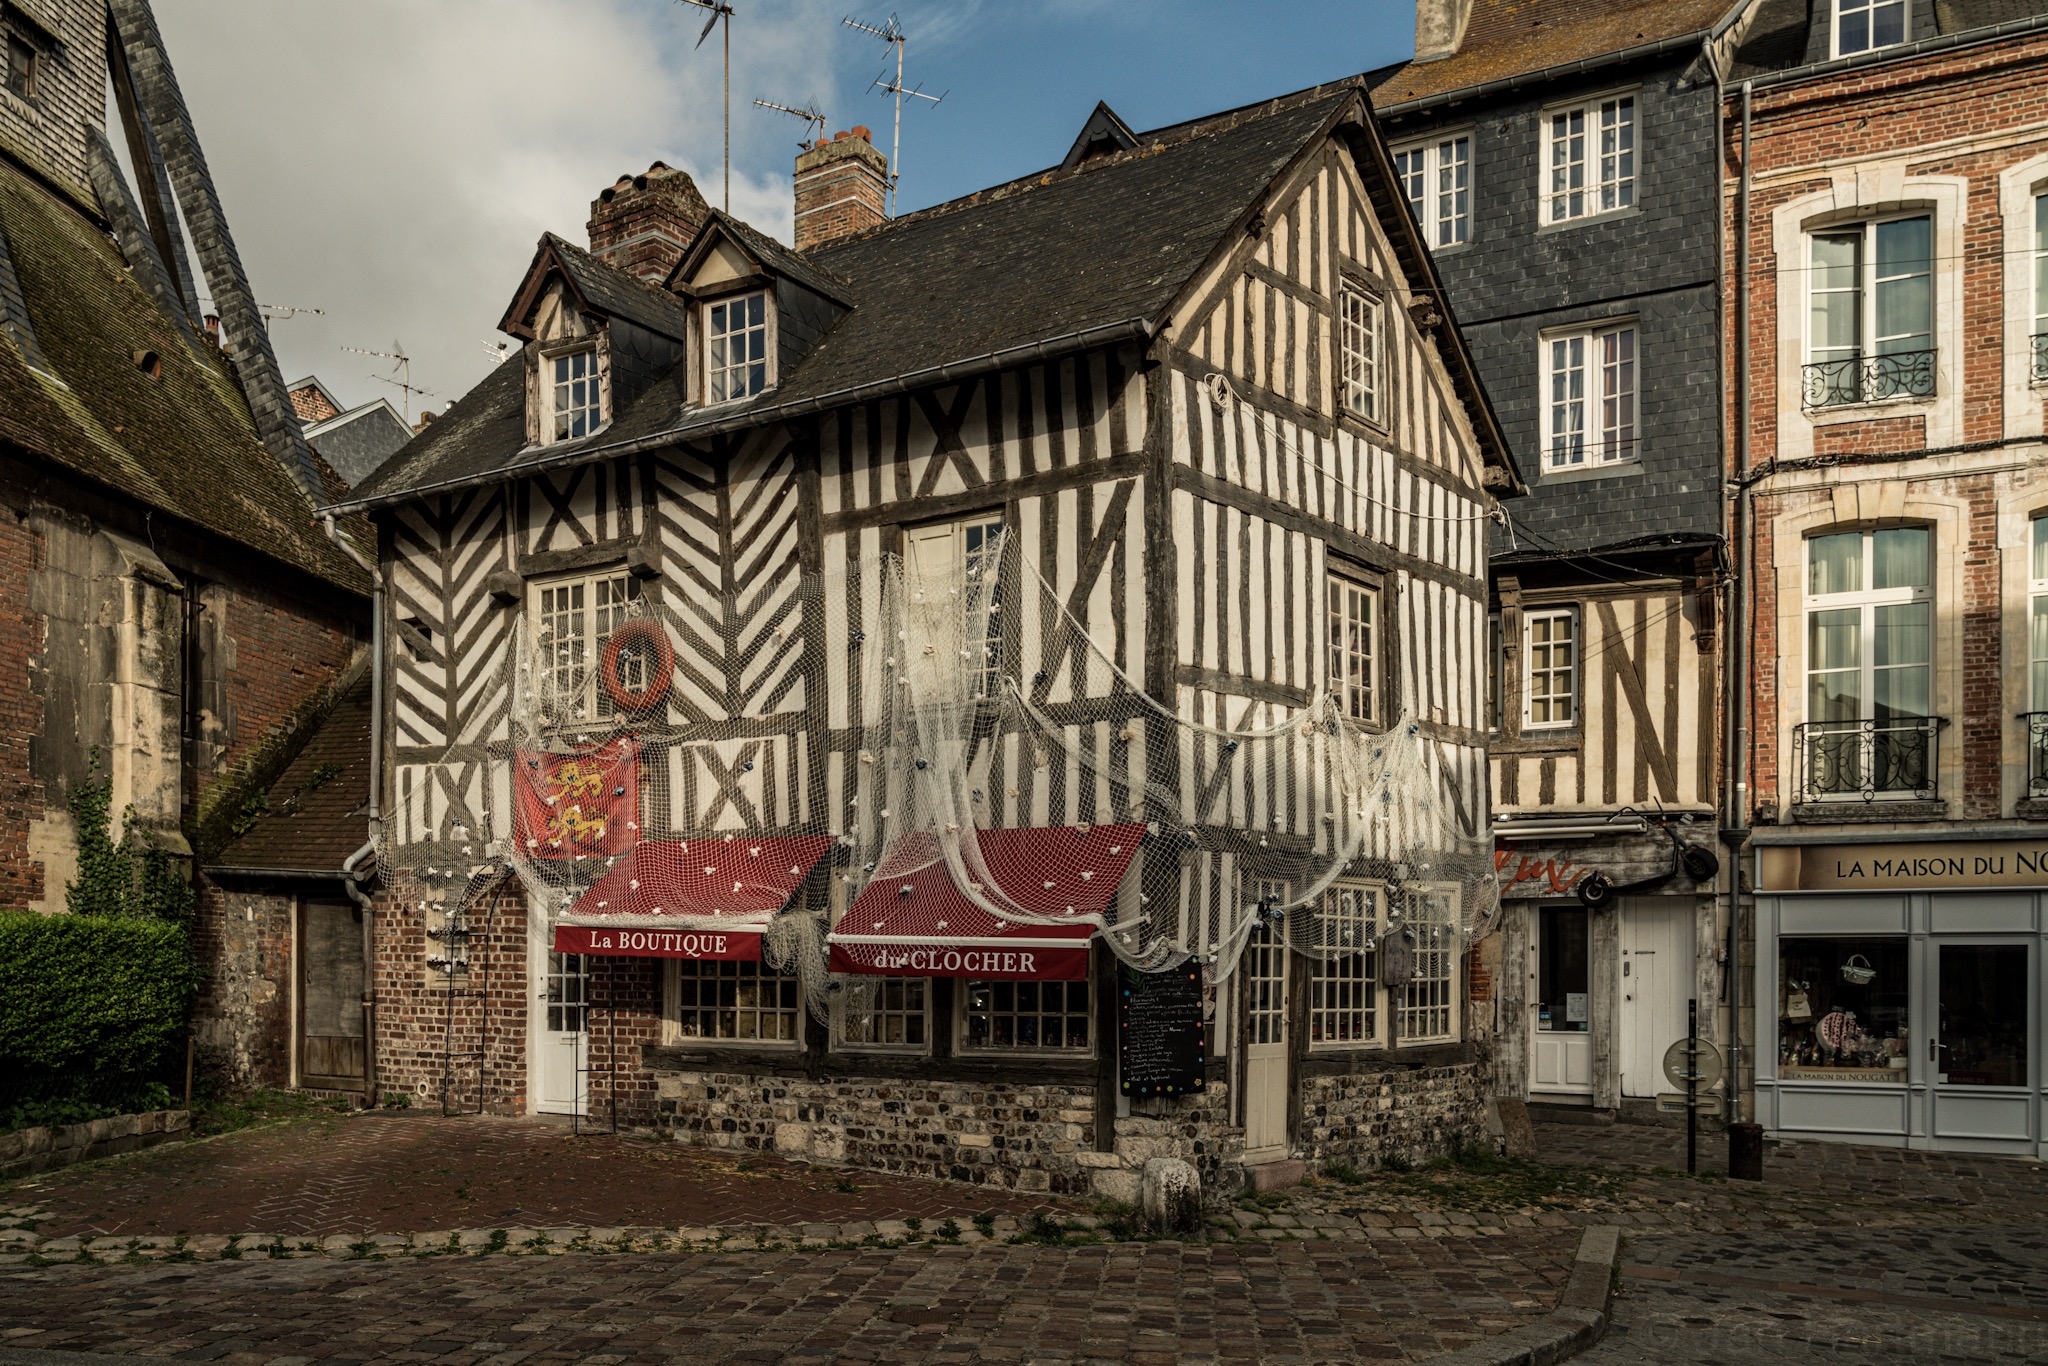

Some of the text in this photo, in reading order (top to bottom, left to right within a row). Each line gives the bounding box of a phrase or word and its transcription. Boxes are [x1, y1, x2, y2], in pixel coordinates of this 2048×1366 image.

[1837, 862, 1864, 878] LA
[1874, 858, 1965, 877] MAISON
[1974, 857, 2004, 875] DU
[590, 930, 727, 957] La BOUTIQUE
[874, 951, 1037, 972] du CLOCHER
[1804, 1073, 1834, 1081] MAISON
[1848, 1073, 1891, 1082] NOUGAT
